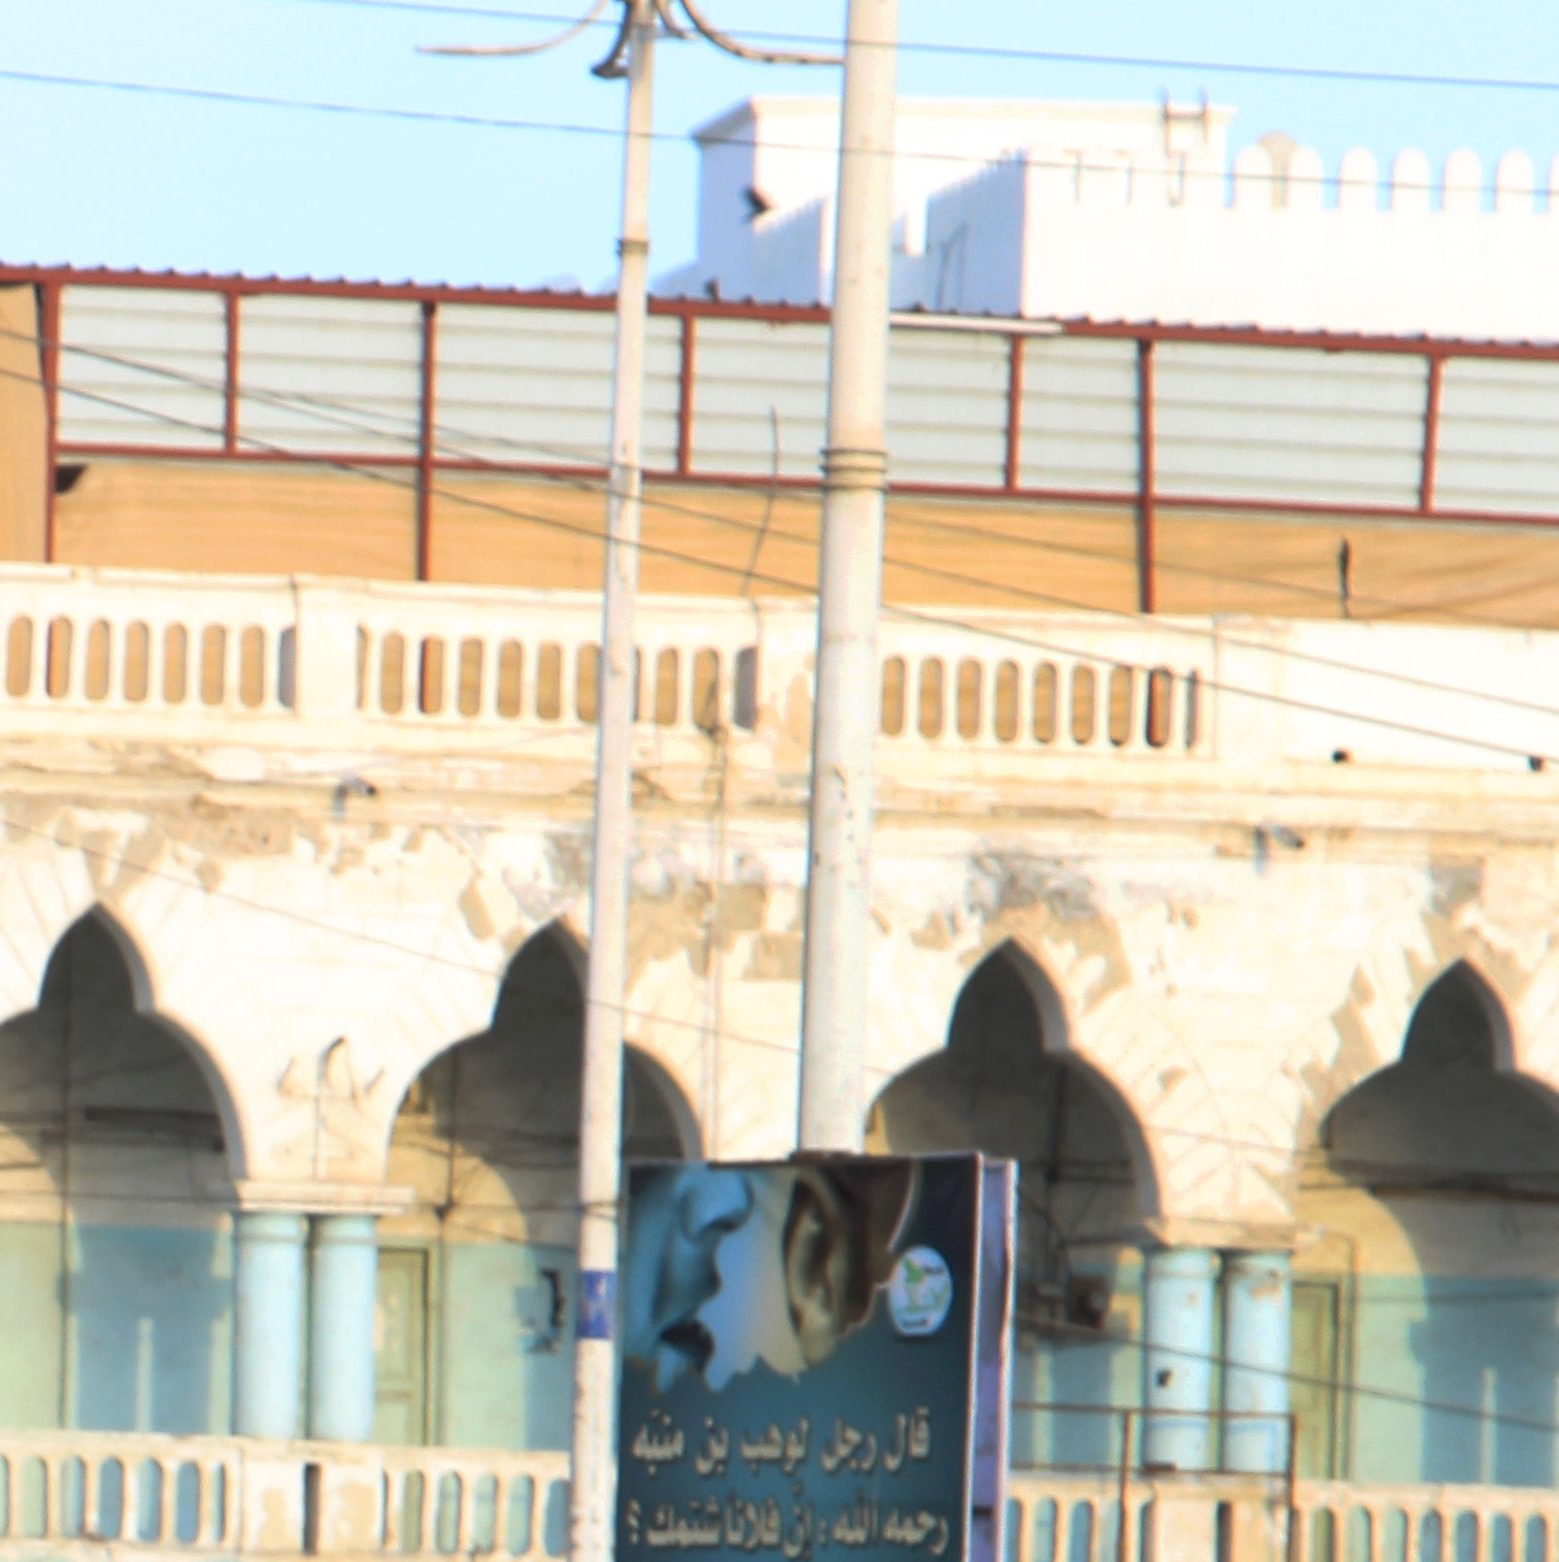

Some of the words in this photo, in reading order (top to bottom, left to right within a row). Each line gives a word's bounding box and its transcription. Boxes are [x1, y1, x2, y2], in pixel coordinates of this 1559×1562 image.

[696, 1414, 729, 1476] بن
[740, 1416, 811, 1476] لوهب
[822, 1416, 880, 1473] رجل
[885, 1405, 930, 1473] قال
[833, 1502, 880, 1545] الله
[883, 1508, 950, 1556] رحمه
